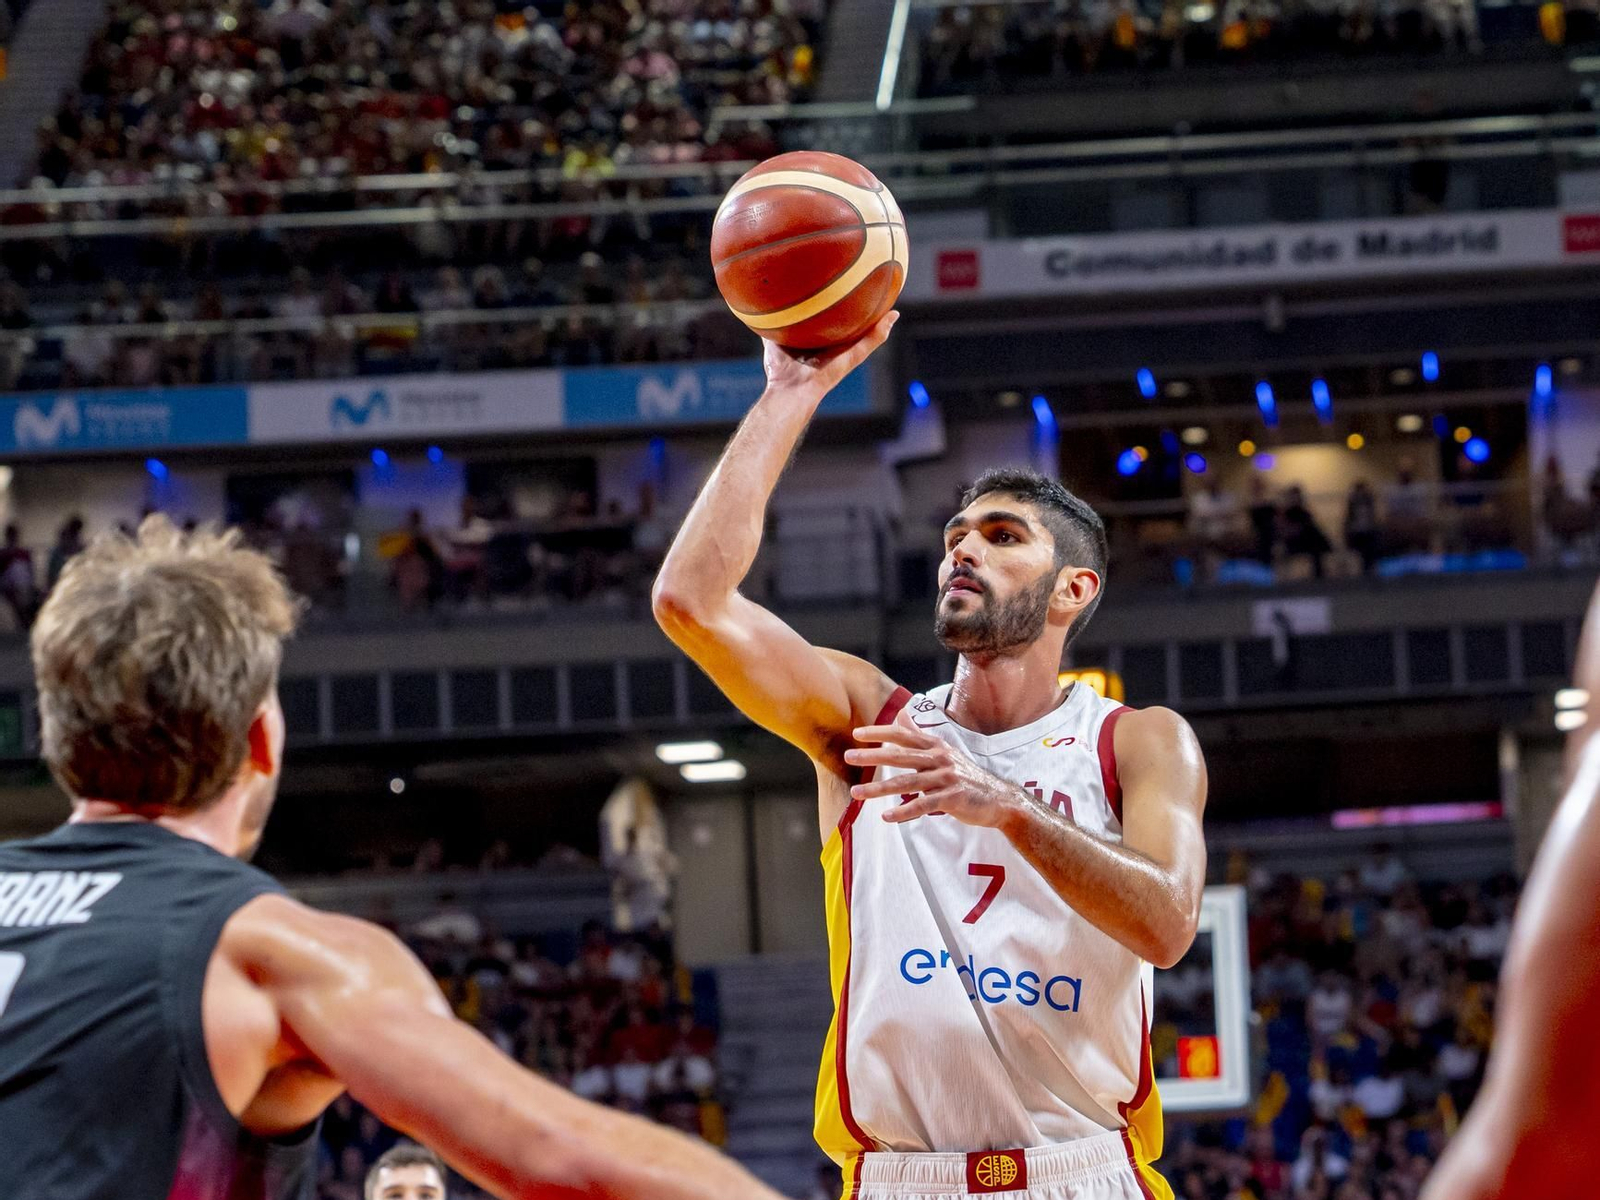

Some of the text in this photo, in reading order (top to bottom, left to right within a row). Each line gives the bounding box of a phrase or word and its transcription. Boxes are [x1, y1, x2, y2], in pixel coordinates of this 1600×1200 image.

[1357, 224, 1498, 256] Madrid
[0, 871, 124, 927] RANZ
[962, 862, 1006, 925] 7
